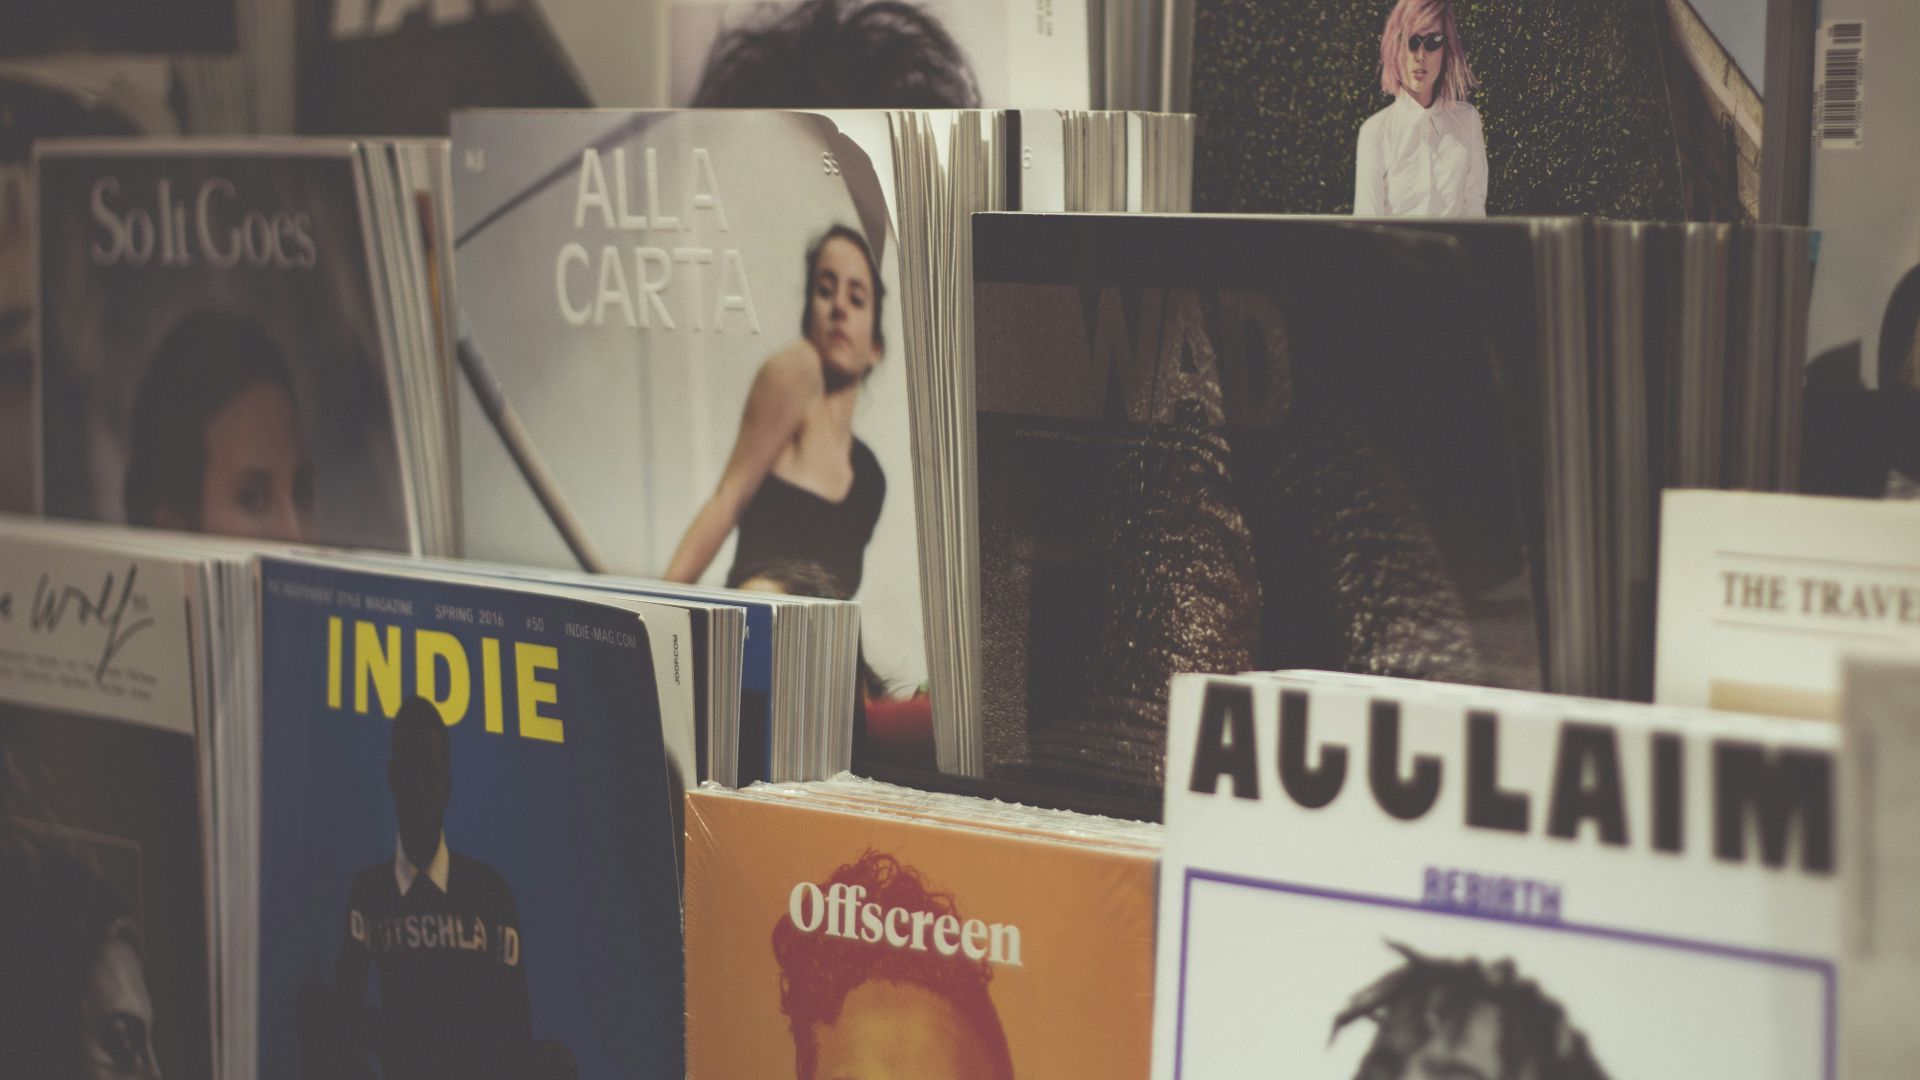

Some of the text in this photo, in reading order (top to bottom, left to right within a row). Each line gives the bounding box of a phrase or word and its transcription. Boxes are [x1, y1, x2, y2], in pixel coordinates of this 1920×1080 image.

[195, 176, 318, 271] Goes
[573, 147, 729, 233] ALLA
[555, 242, 761, 334] CARTA
[1066, 285, 1294, 428] WAD
[336, 589, 361, 608] STYLE
[364, 595, 414, 617] MAGAZINE
[435, 604, 474, 624] SPRING
[479, 608, 505, 626] 2016
[525, 616, 545, 633] #50
[564, 622, 638, 649] INDIE-MAG.COM
[1721, 572, 1785, 610] THE
[327, 615, 564, 743] INDIE
[1188, 681, 1838, 876] ACCLAIM
[789, 881, 1024, 967] Offscreen
[1421, 864, 1562, 922] REBIRTH
